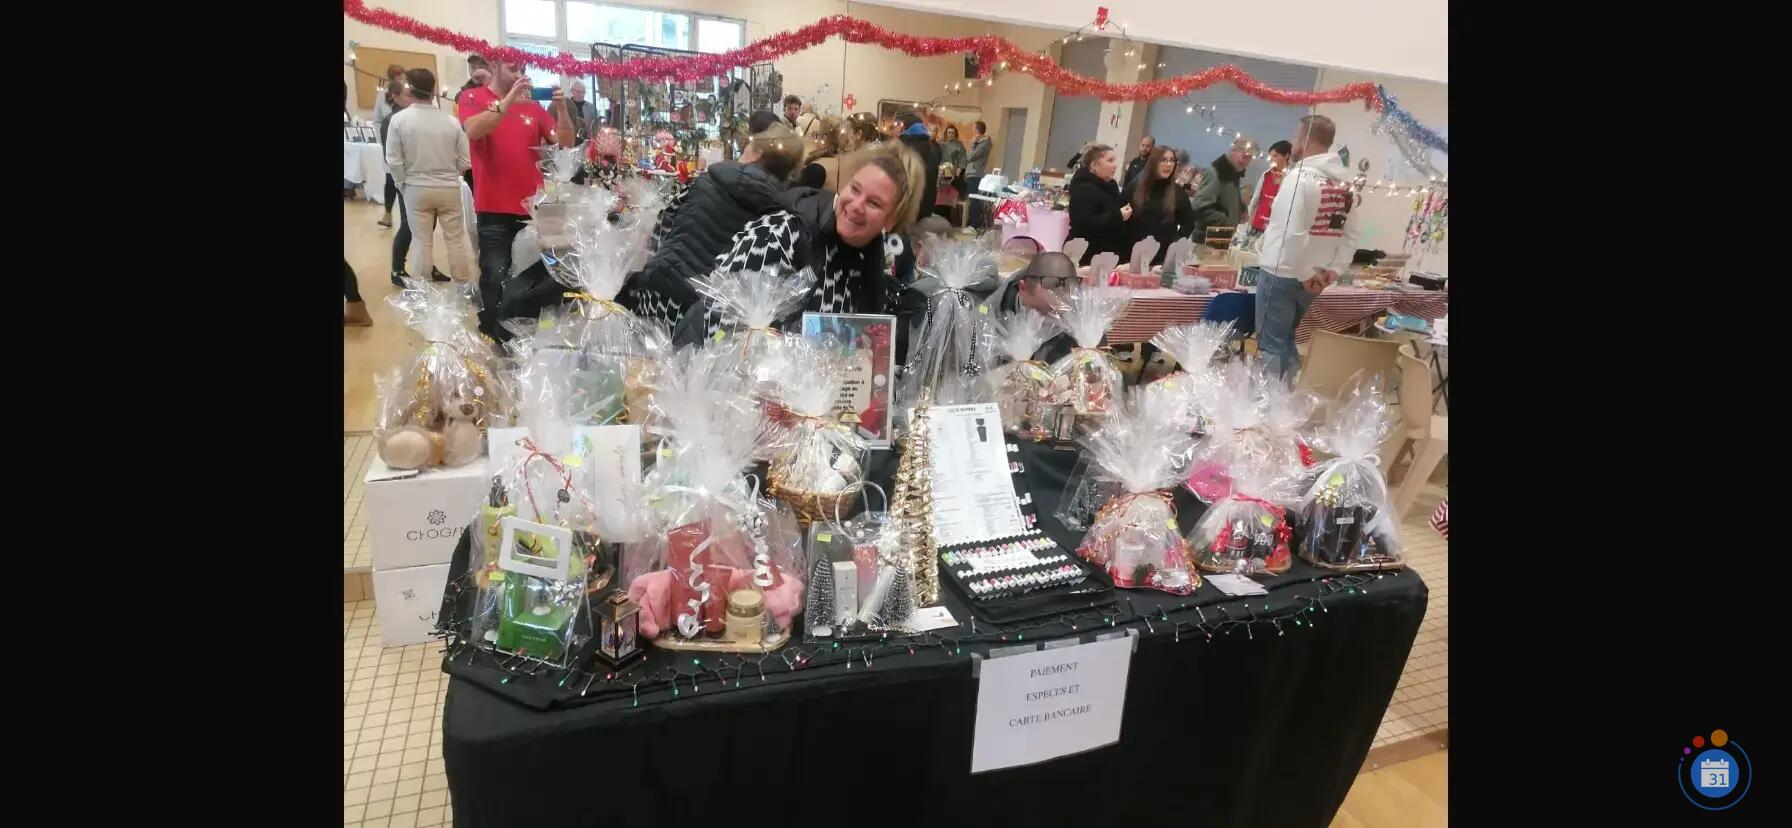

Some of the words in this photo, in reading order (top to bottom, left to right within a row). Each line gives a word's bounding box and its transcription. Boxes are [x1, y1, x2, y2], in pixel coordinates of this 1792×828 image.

[1030, 661, 1078, 678] PAIEMENT
[1068, 684, 1080, 695] ET
[1009, 714, 1042, 727] CARTE
[1044, 704, 1092, 721] BANCAIRE
